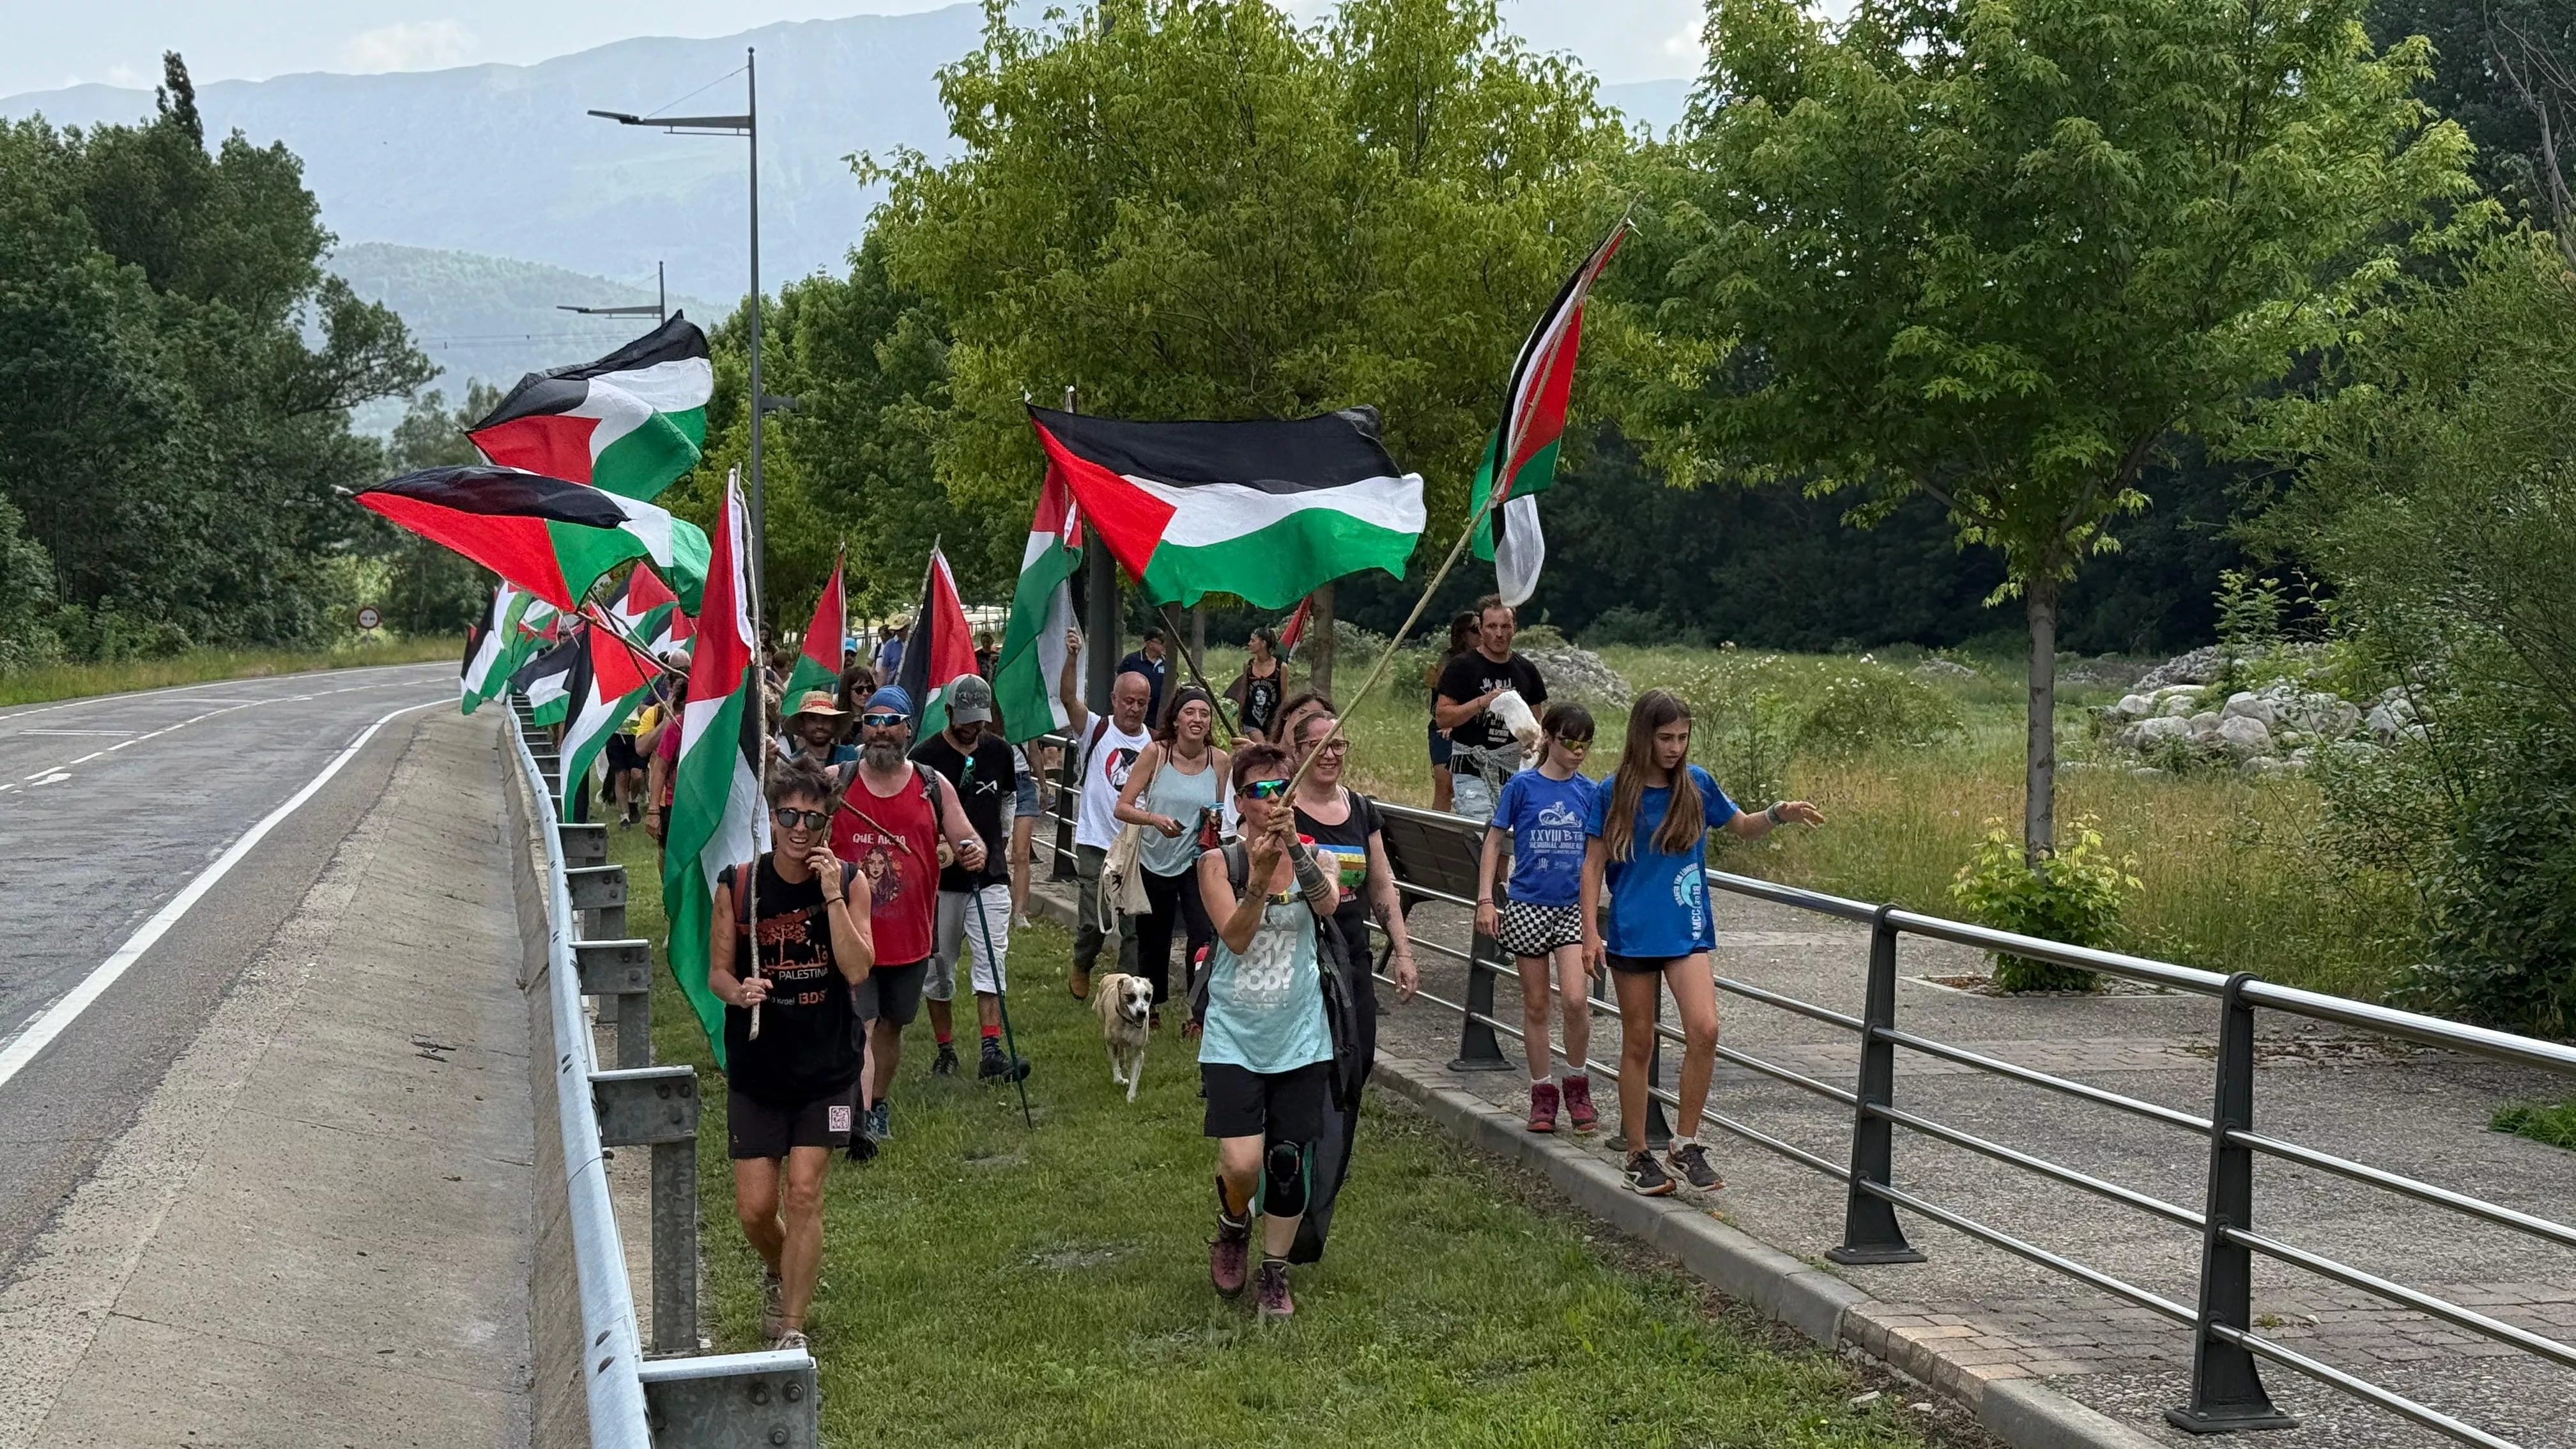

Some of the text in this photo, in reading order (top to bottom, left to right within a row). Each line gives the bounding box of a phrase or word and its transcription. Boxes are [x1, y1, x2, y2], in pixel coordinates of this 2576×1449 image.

[852, 832, 875, 845] QUE
[1529, 829, 1561, 841] XXVIII
[1691, 907, 1702, 930] MCC
[1247, 930, 1298, 952] OVE
[779, 967, 828, 981] PALESTINA
[799, 988, 828, 1006] BDS
